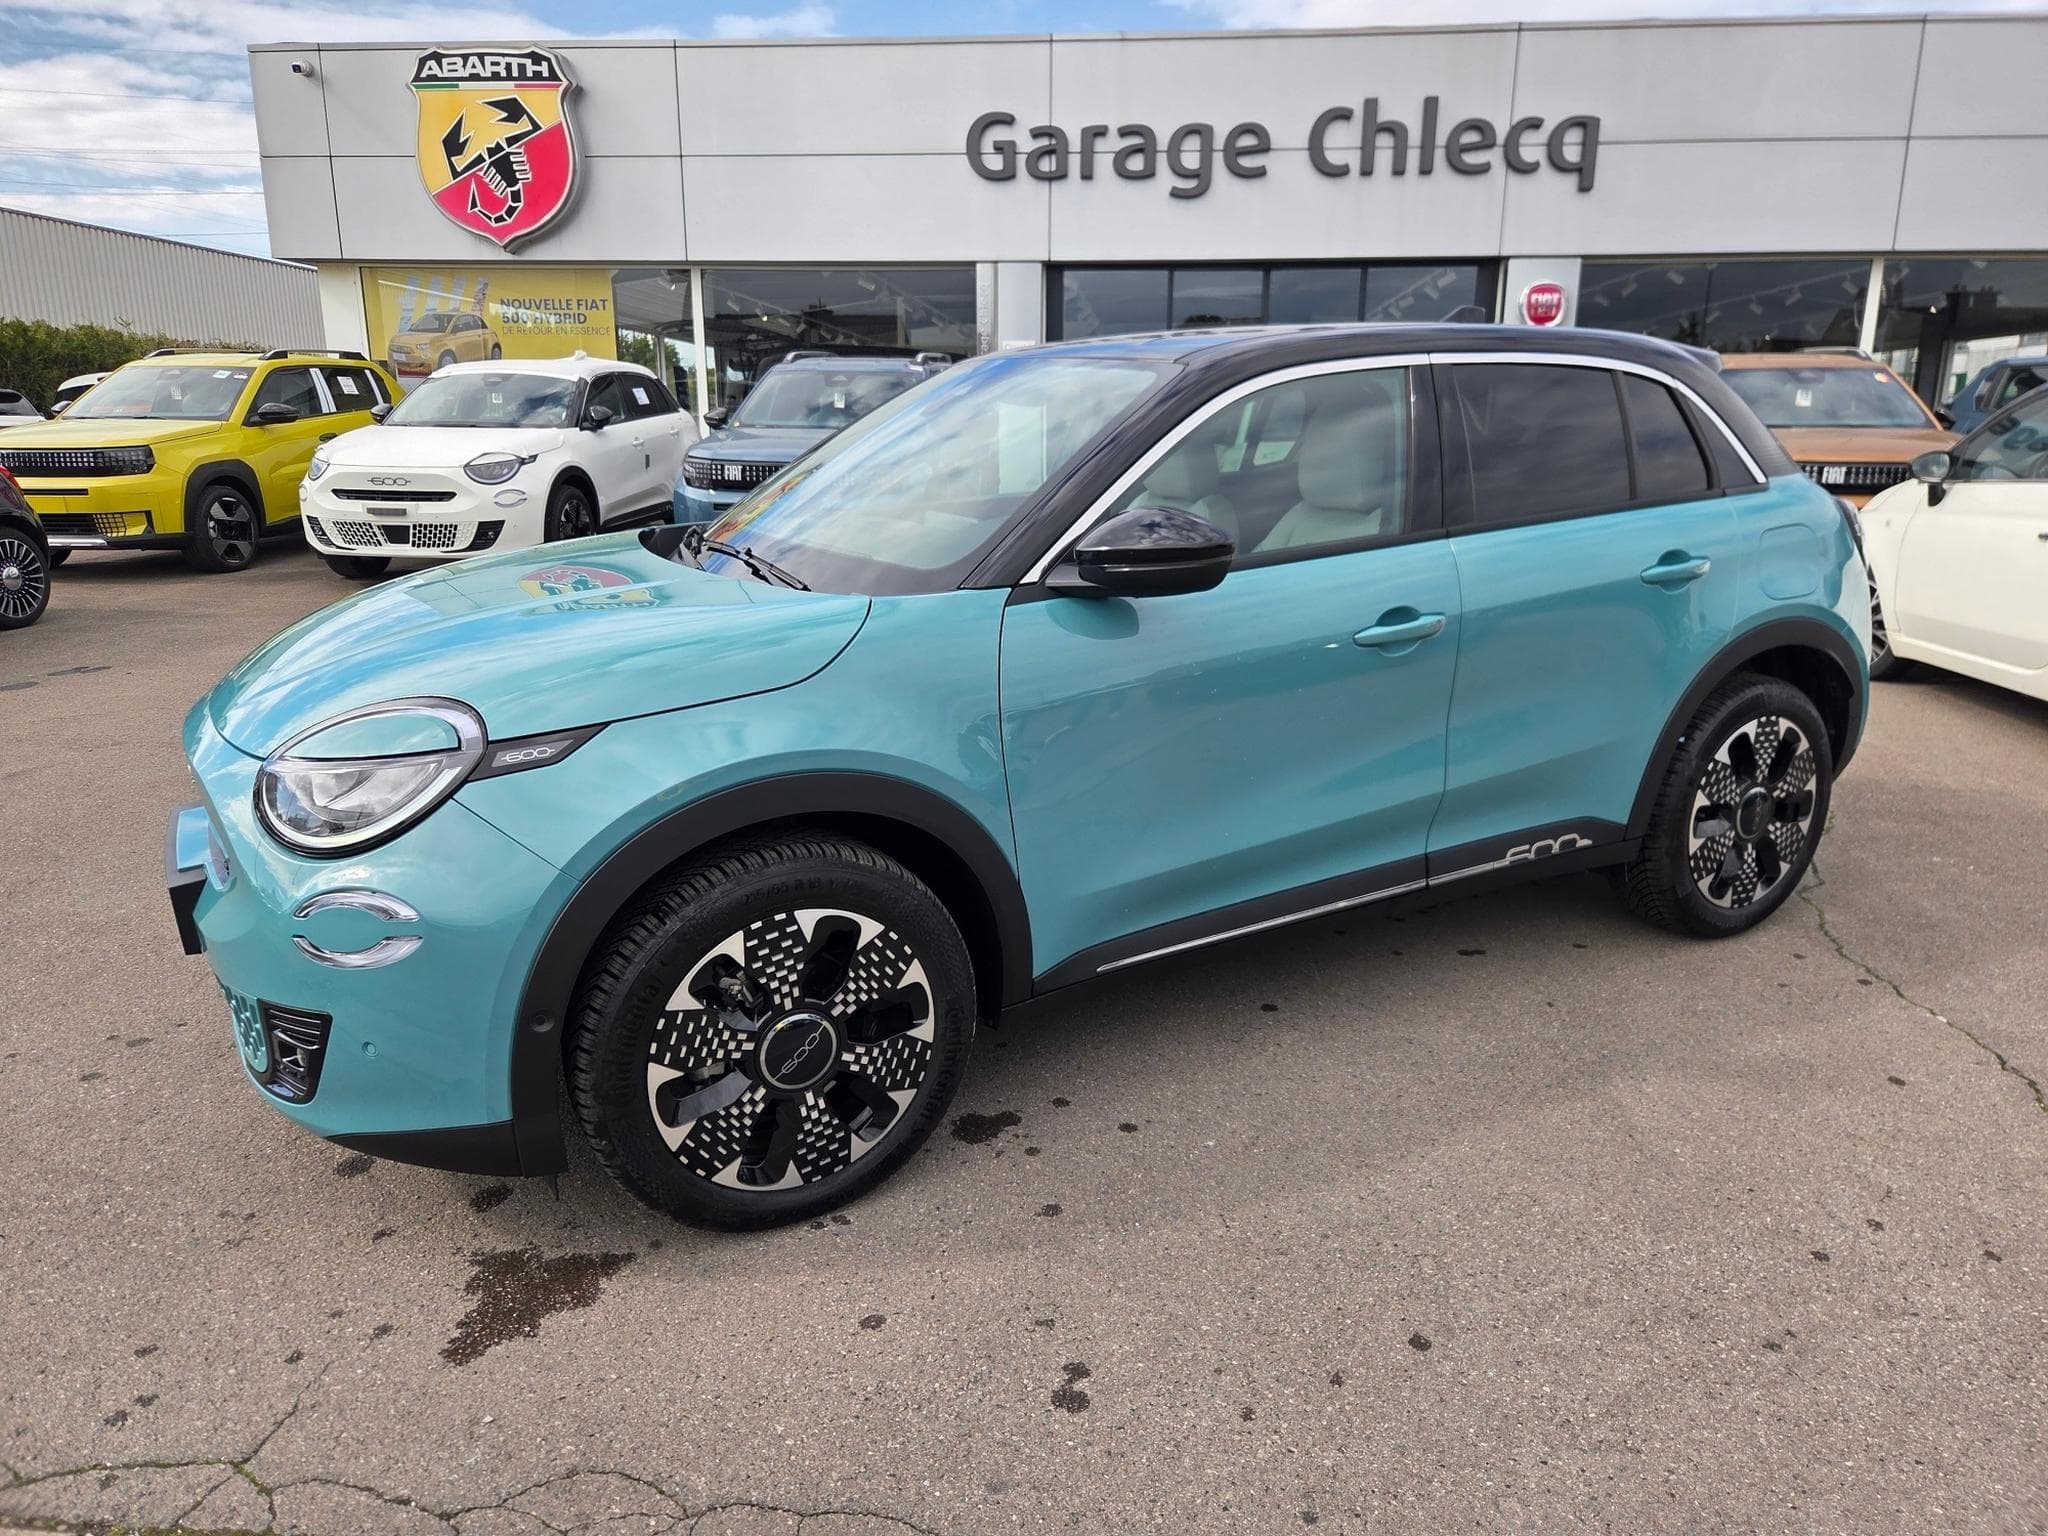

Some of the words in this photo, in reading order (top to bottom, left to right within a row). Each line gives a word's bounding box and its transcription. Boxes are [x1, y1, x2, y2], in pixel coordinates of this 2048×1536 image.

[420, 55, 549, 78] ABARTH
[966, 111, 1271, 199] Garage
[1308, 95, 1601, 192] Chlecq
[500, 298, 573, 311] NOUVELLE
[577, 298, 608, 311] FIAT
[1531, 292, 1561, 315] FIAT
[502, 311, 529, 324] 500
[533, 312, 587, 325] HYBRID
[517, 326, 553, 336] RETOUR
[724, 465, 743, 481] FIAT
[1821, 466, 1848, 484] FIAT
[368, 477, 411, 486] 600
[502, 747, 555, 762] 600
[778, 1029, 821, 1077] 600
